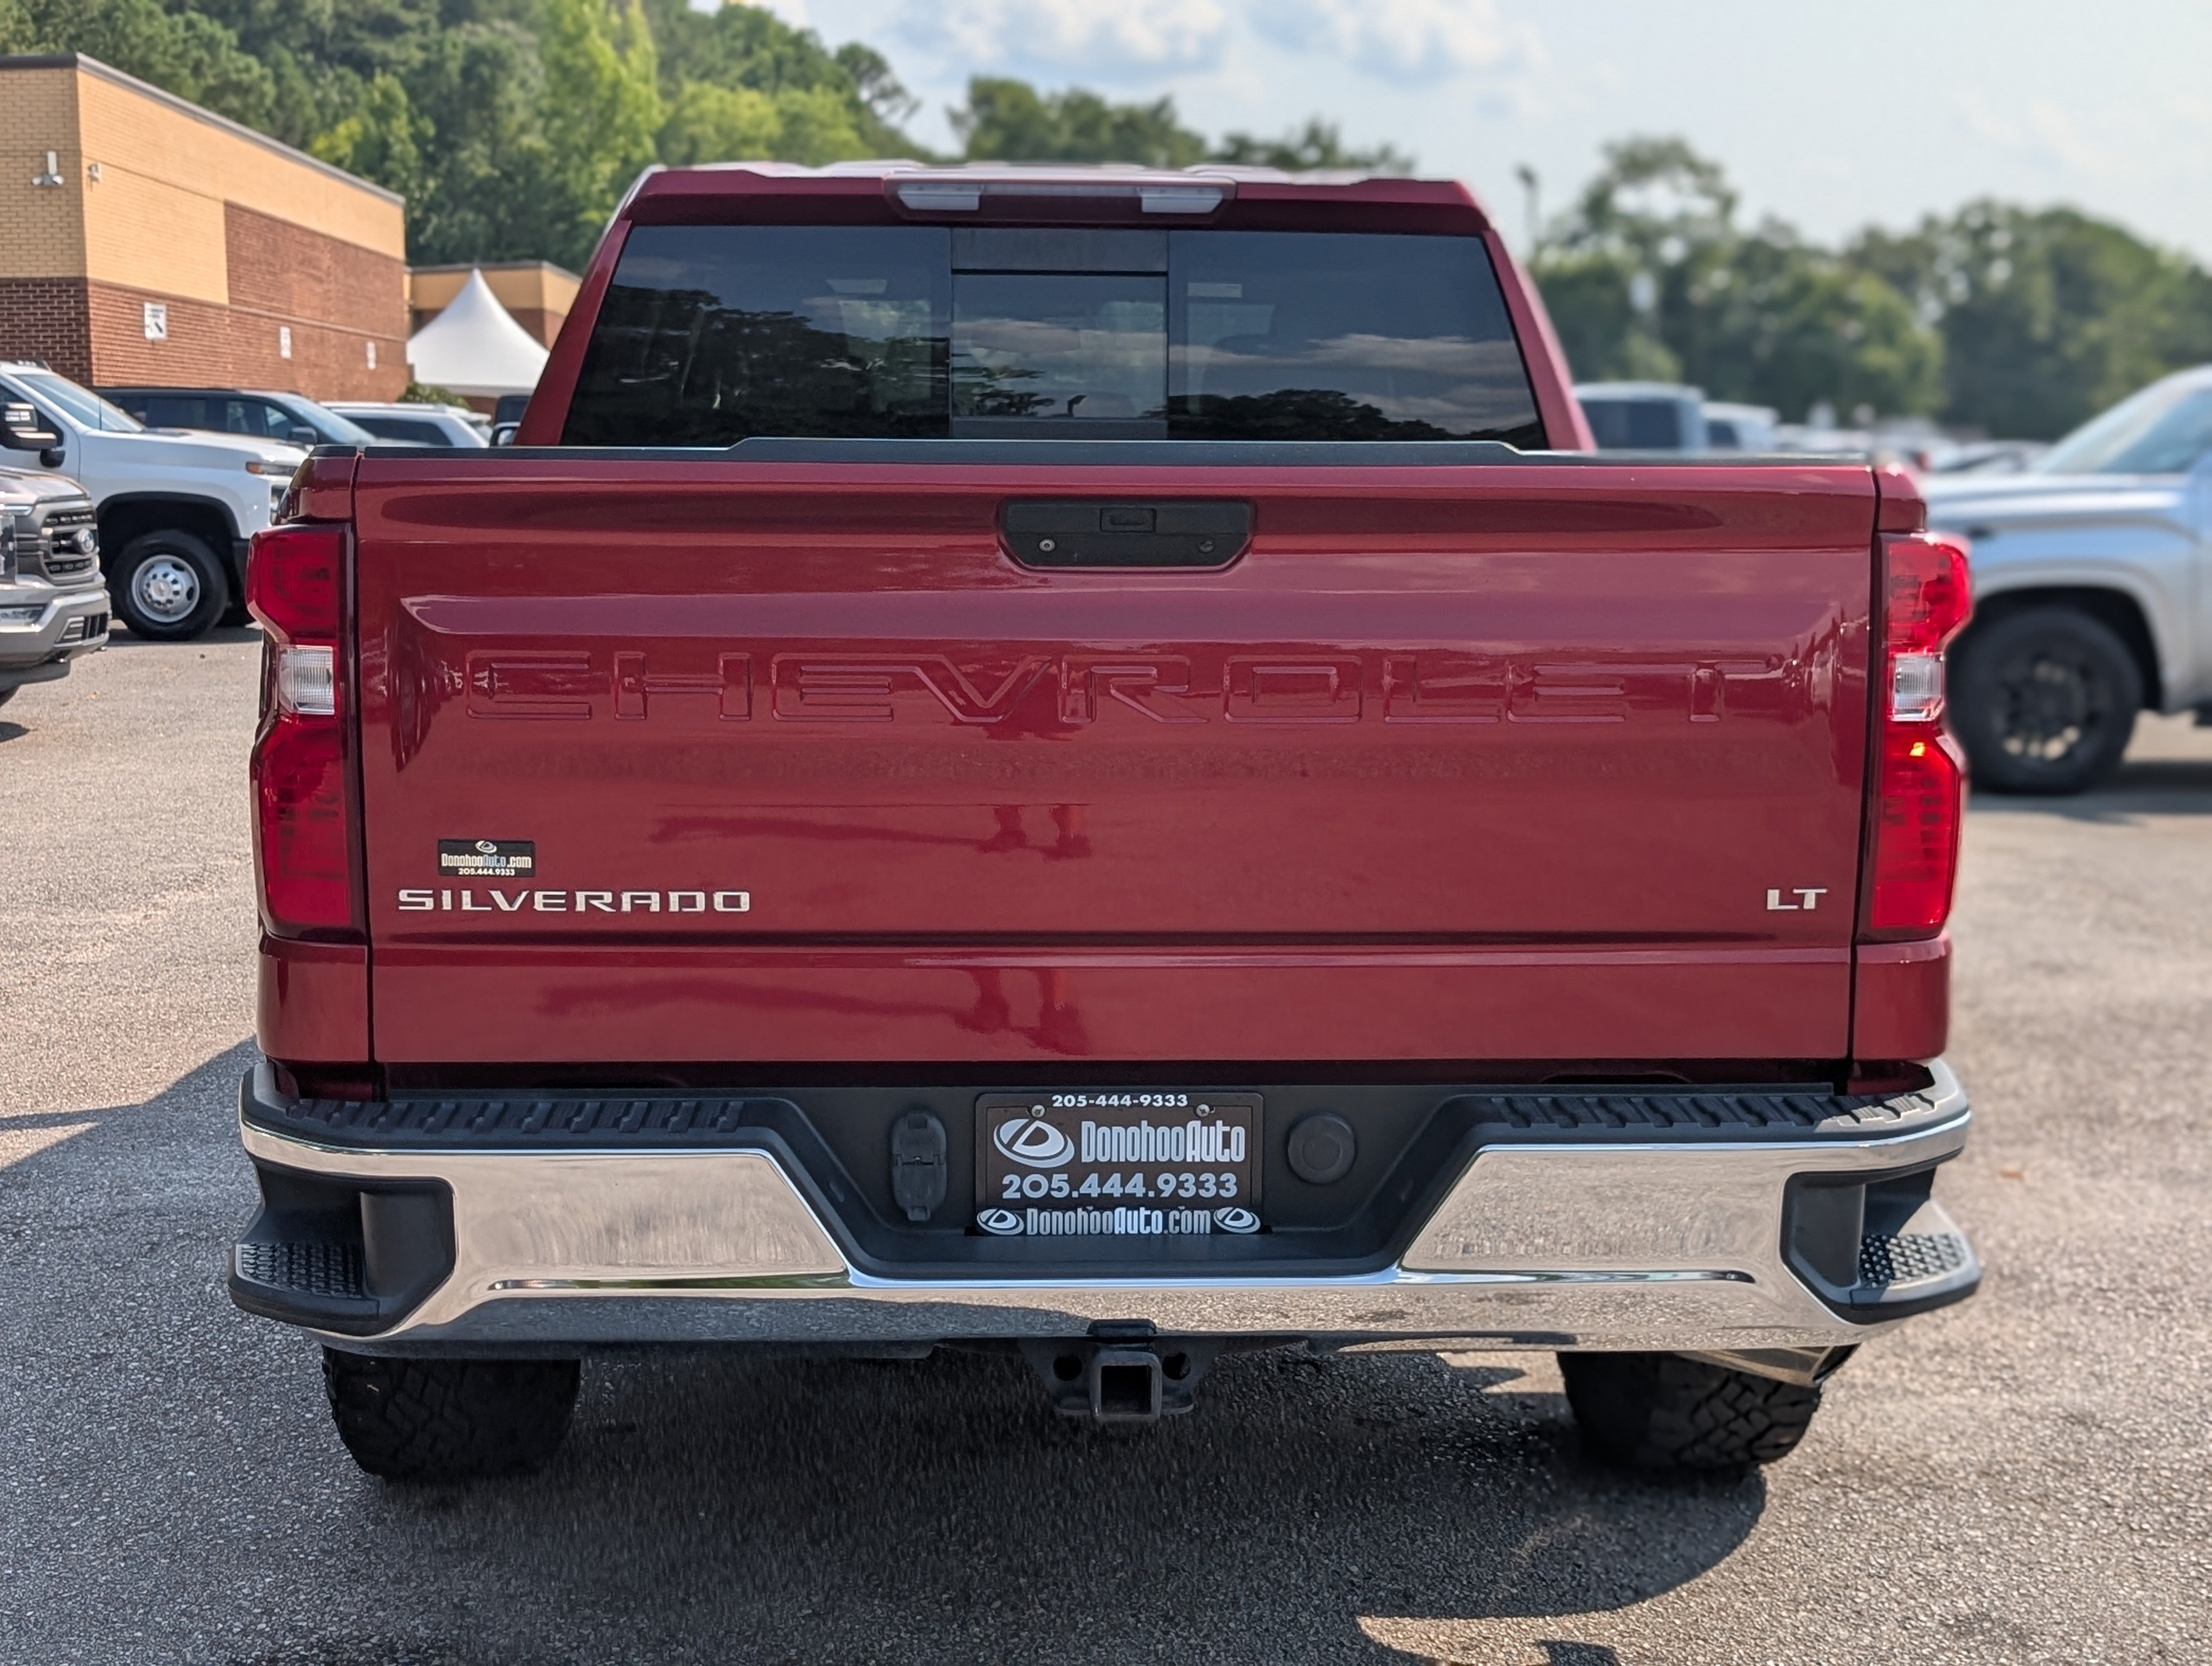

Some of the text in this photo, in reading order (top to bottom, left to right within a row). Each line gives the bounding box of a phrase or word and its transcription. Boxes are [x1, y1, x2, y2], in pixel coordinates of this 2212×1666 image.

[466, 651, 1783, 723] CHEVROLET
[441, 853, 532, 868] DonohooAuto.com
[458, 868, 515, 876] 205.444.9333
[398, 890, 750, 912] SILVERADO
[1767, 888, 1827, 910] LT
[1052, 1094, 1188, 1107] 205-444-9333
[1081, 1120, 1246, 1162] DonohooAuto
[1002, 1172, 1238, 1199] 205.444.9333
[1026, 1207, 1211, 1235] DonohooAuto.com
